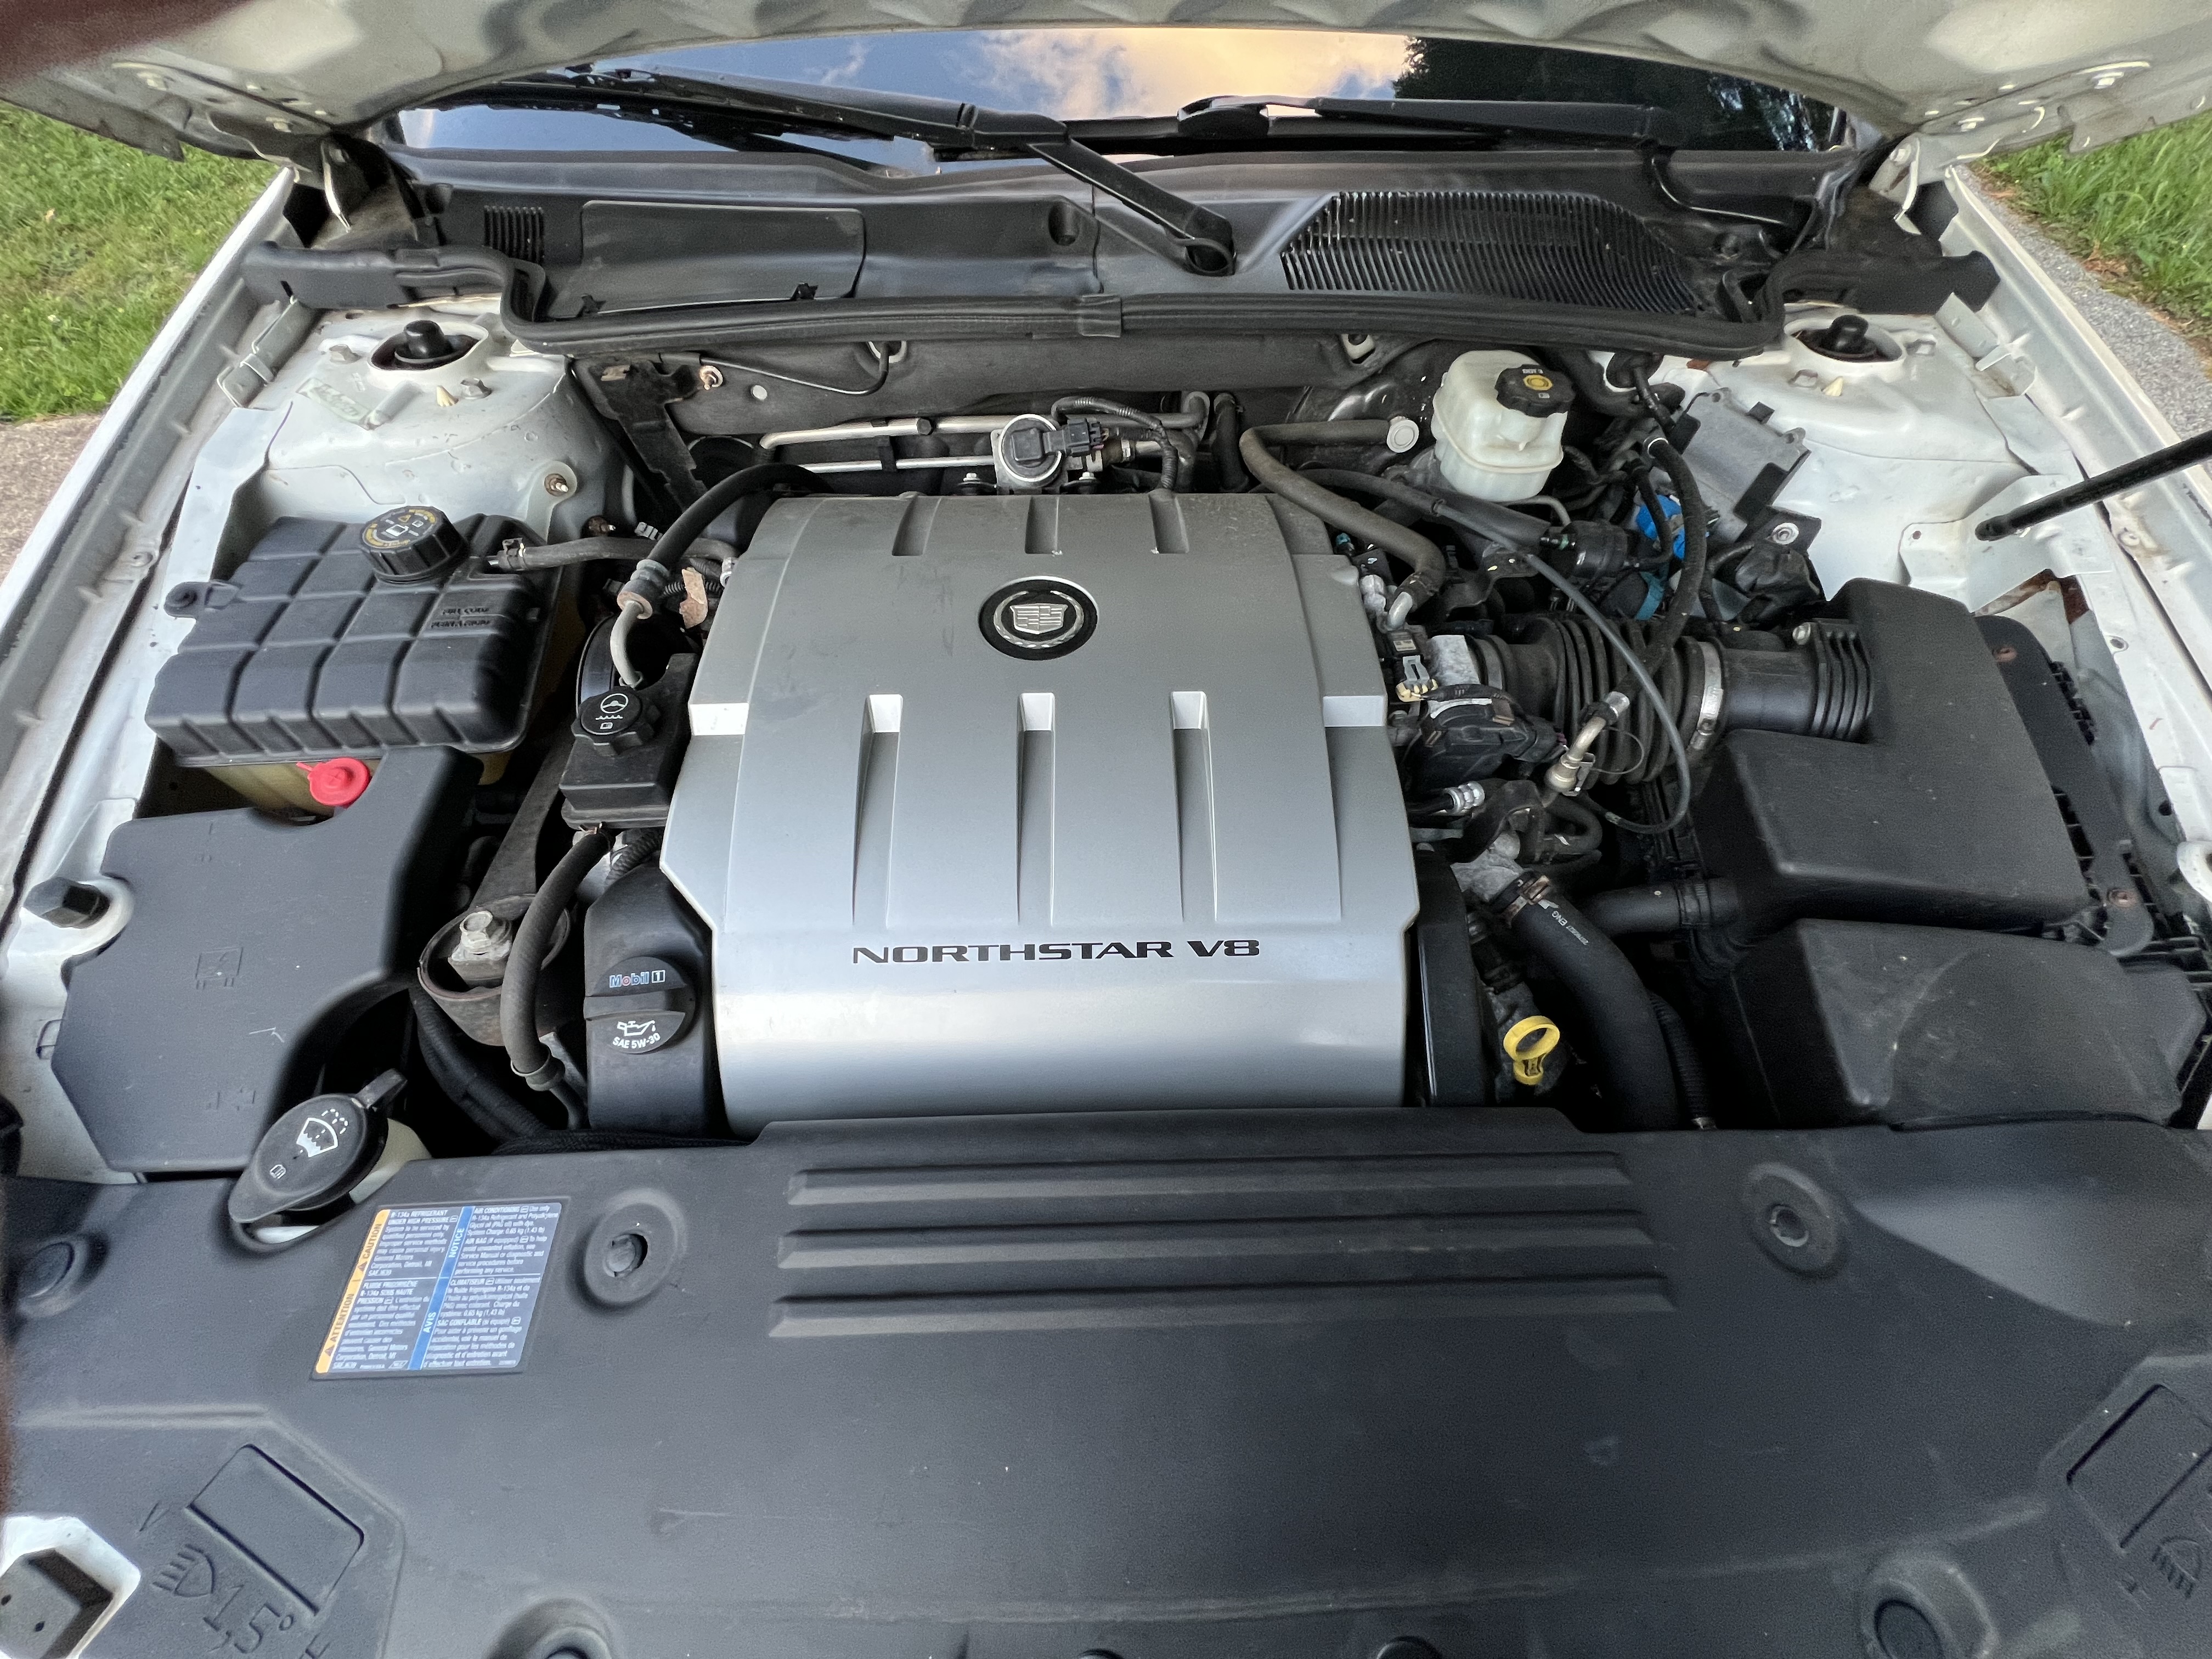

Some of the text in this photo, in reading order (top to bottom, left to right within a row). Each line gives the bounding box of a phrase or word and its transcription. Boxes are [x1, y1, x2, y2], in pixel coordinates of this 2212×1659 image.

[1551, 910, 1568, 926] ENG
[853, 939, 1261, 964] NORTHSTAR V8
[609, 969, 665, 988] Mobil 1
[612, 1032, 661, 1049] SAE 5W-30
[363, 1223, 382, 1259] CAUTION
[448, 1228, 465, 1258] NOTICE
[331, 1294, 355, 1342] ATTENTION
[423, 1312, 437, 1333] AVIS
